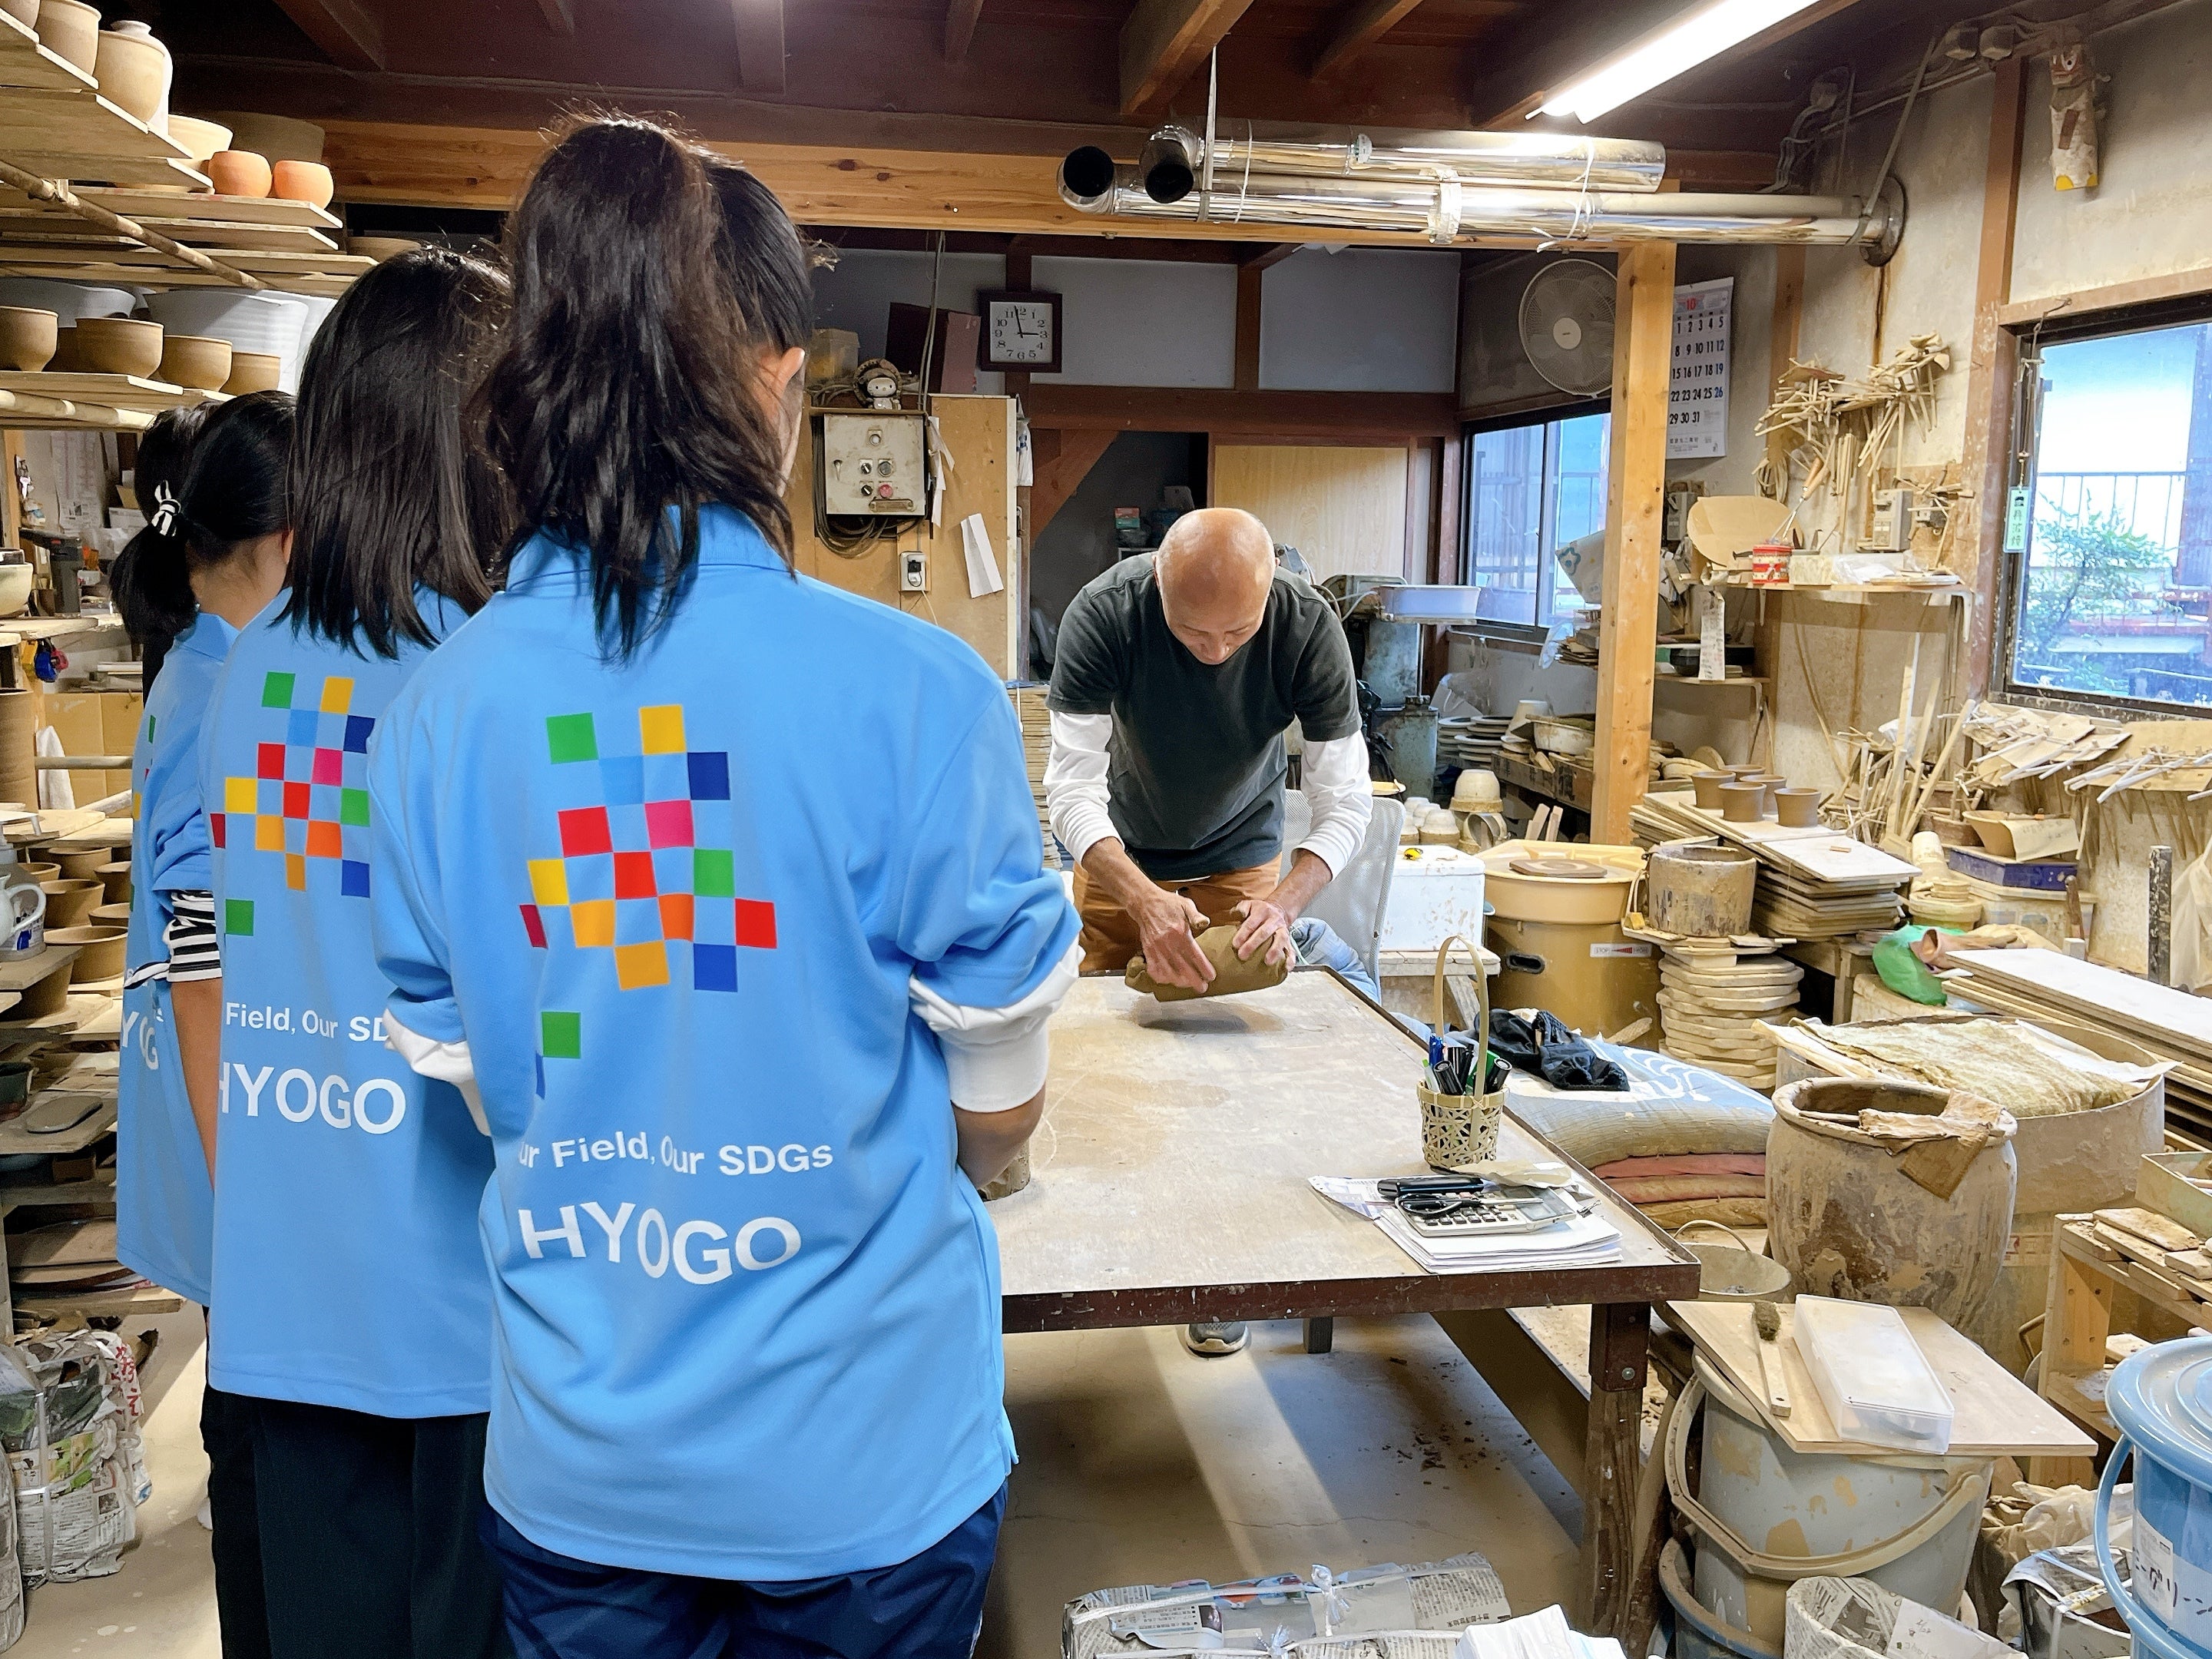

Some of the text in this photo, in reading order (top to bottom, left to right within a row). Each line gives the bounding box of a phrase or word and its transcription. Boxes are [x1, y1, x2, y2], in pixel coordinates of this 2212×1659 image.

[1686, 297, 1697, 310] 10
[997, 319, 1008, 327] 10
[1037, 320, 1045, 328] 2
[1677, 316, 1724, 334] 1 2 3 4 5
[997, 340, 1006, 349] 8
[1675, 339, 1724, 356] 8 9 10 11 12
[1017, 352, 1025, 360] 6
[1672, 363, 1724, 379] 15 16 17 18 19
[1671, 386, 1724, 402] 22 23 24 25 26
[1669, 413, 1678, 424] 29
[1681, 412, 1690, 424] 30
[1692, 411, 1700, 422] 31
[226, 1002, 389, 1043] Field, Our SD
[518, 1131, 834, 1176] ur Field, Our SDGs
[518, 1200, 802, 1286] HYOGO
